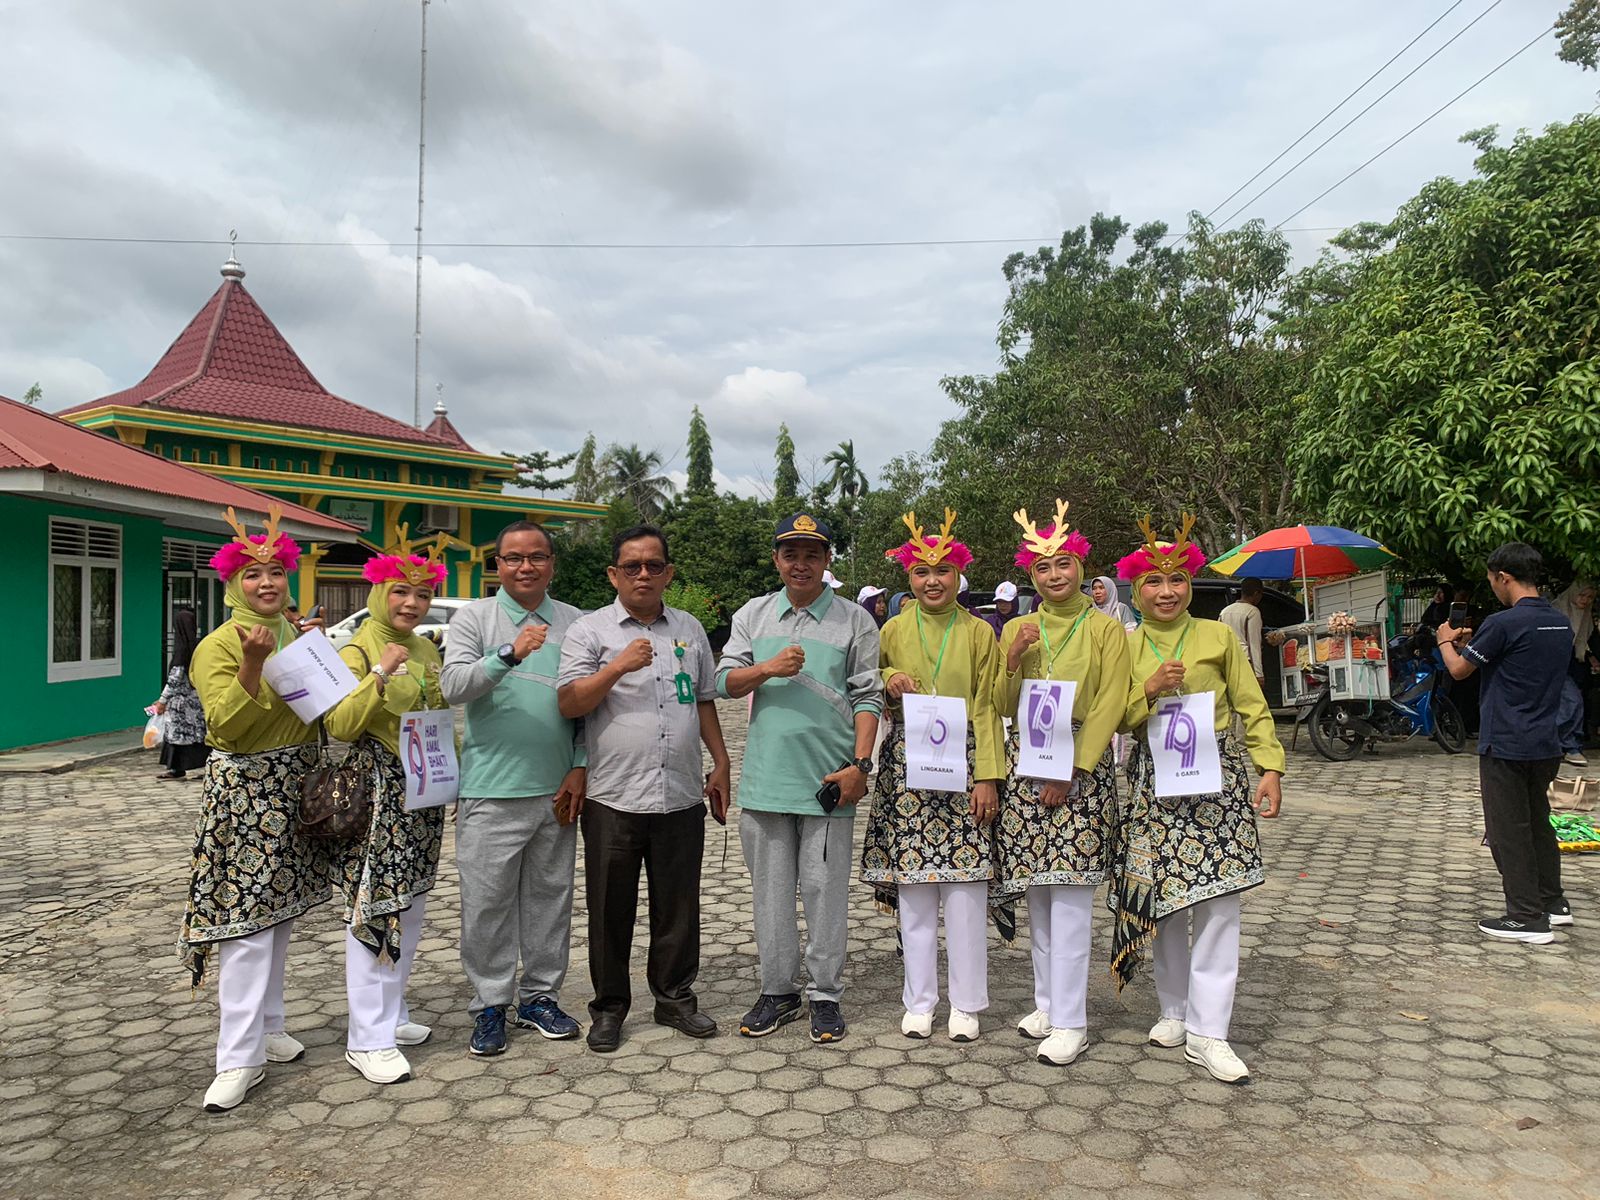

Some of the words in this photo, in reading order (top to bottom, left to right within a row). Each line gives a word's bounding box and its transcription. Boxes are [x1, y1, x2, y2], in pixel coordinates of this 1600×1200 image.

[307, 646, 324, 667] PANAH
[323, 666, 340, 686] TANDA
[425, 725, 437, 737] HARI
[1158, 703, 1197, 768] 79
[920, 765, 954, 774] LINGKARAN
[1180, 769, 1200, 777] GARIS
